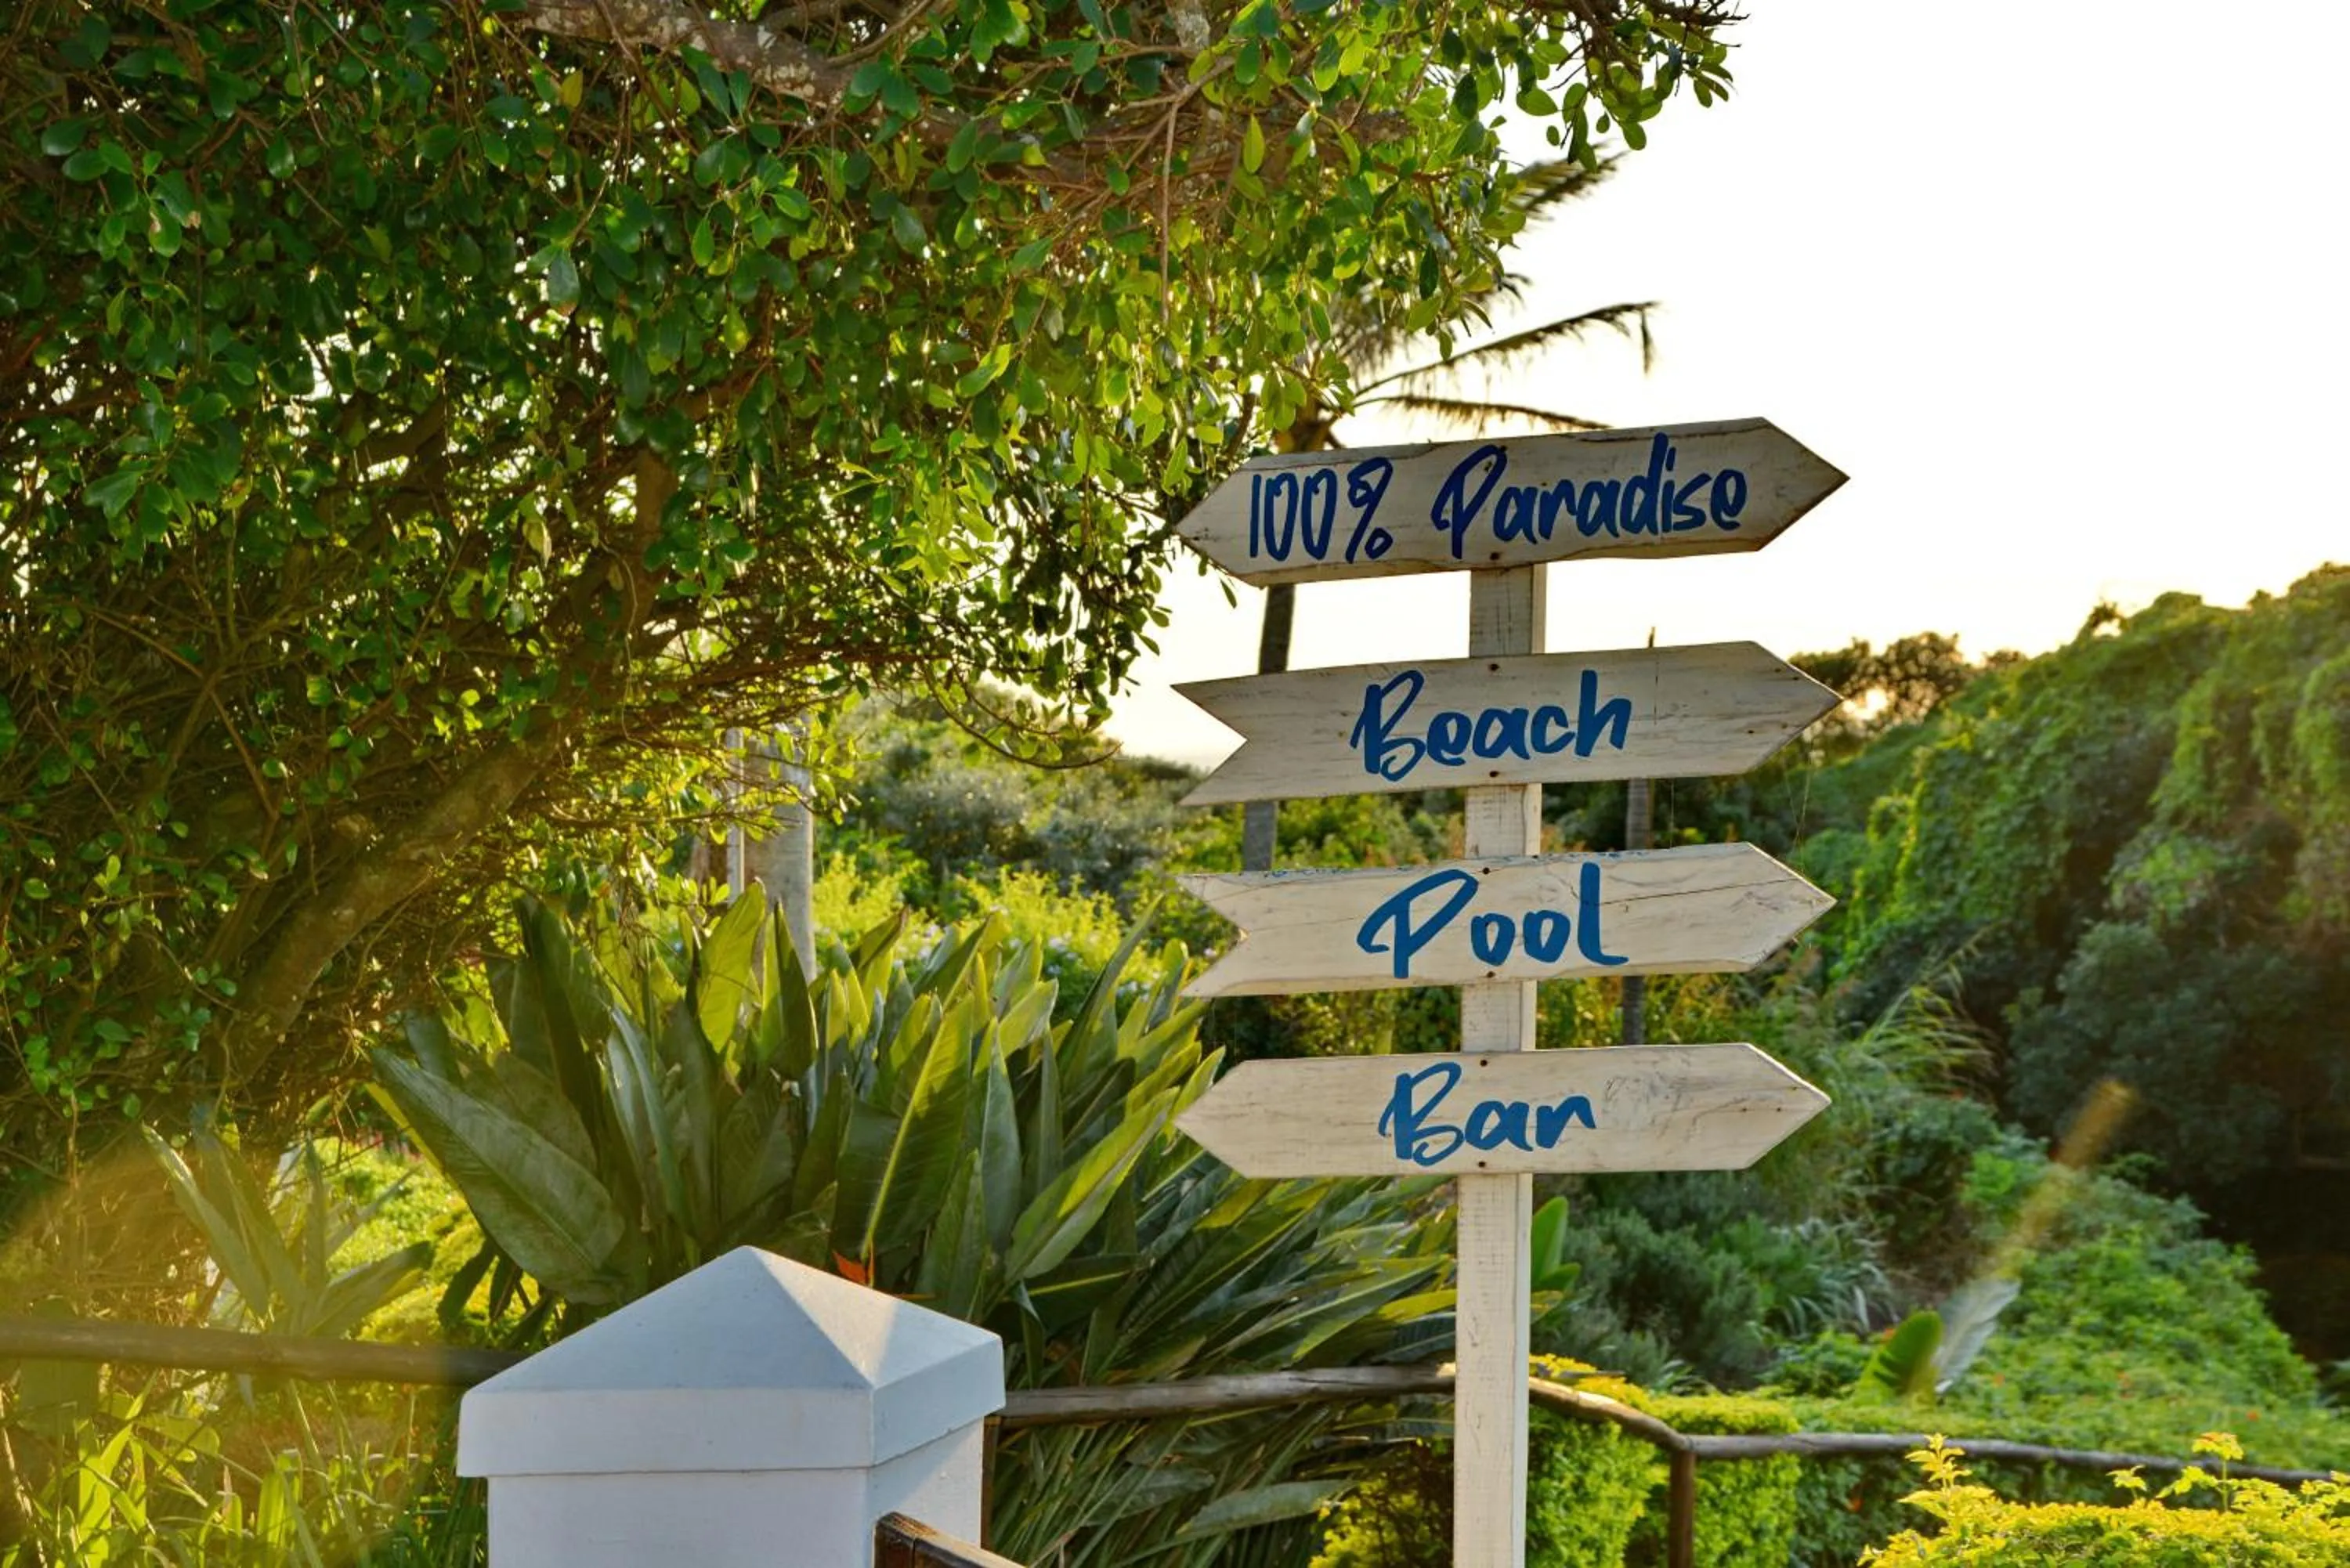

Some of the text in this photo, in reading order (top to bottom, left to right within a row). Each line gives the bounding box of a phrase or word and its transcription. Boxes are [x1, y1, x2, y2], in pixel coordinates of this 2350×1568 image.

[1249, 432, 1748, 563] 100% Paradise
[1349, 669, 1632, 782] Beach
[1355, 860, 1629, 979] Pool
[1378, 1061, 1597, 1166] Bar
